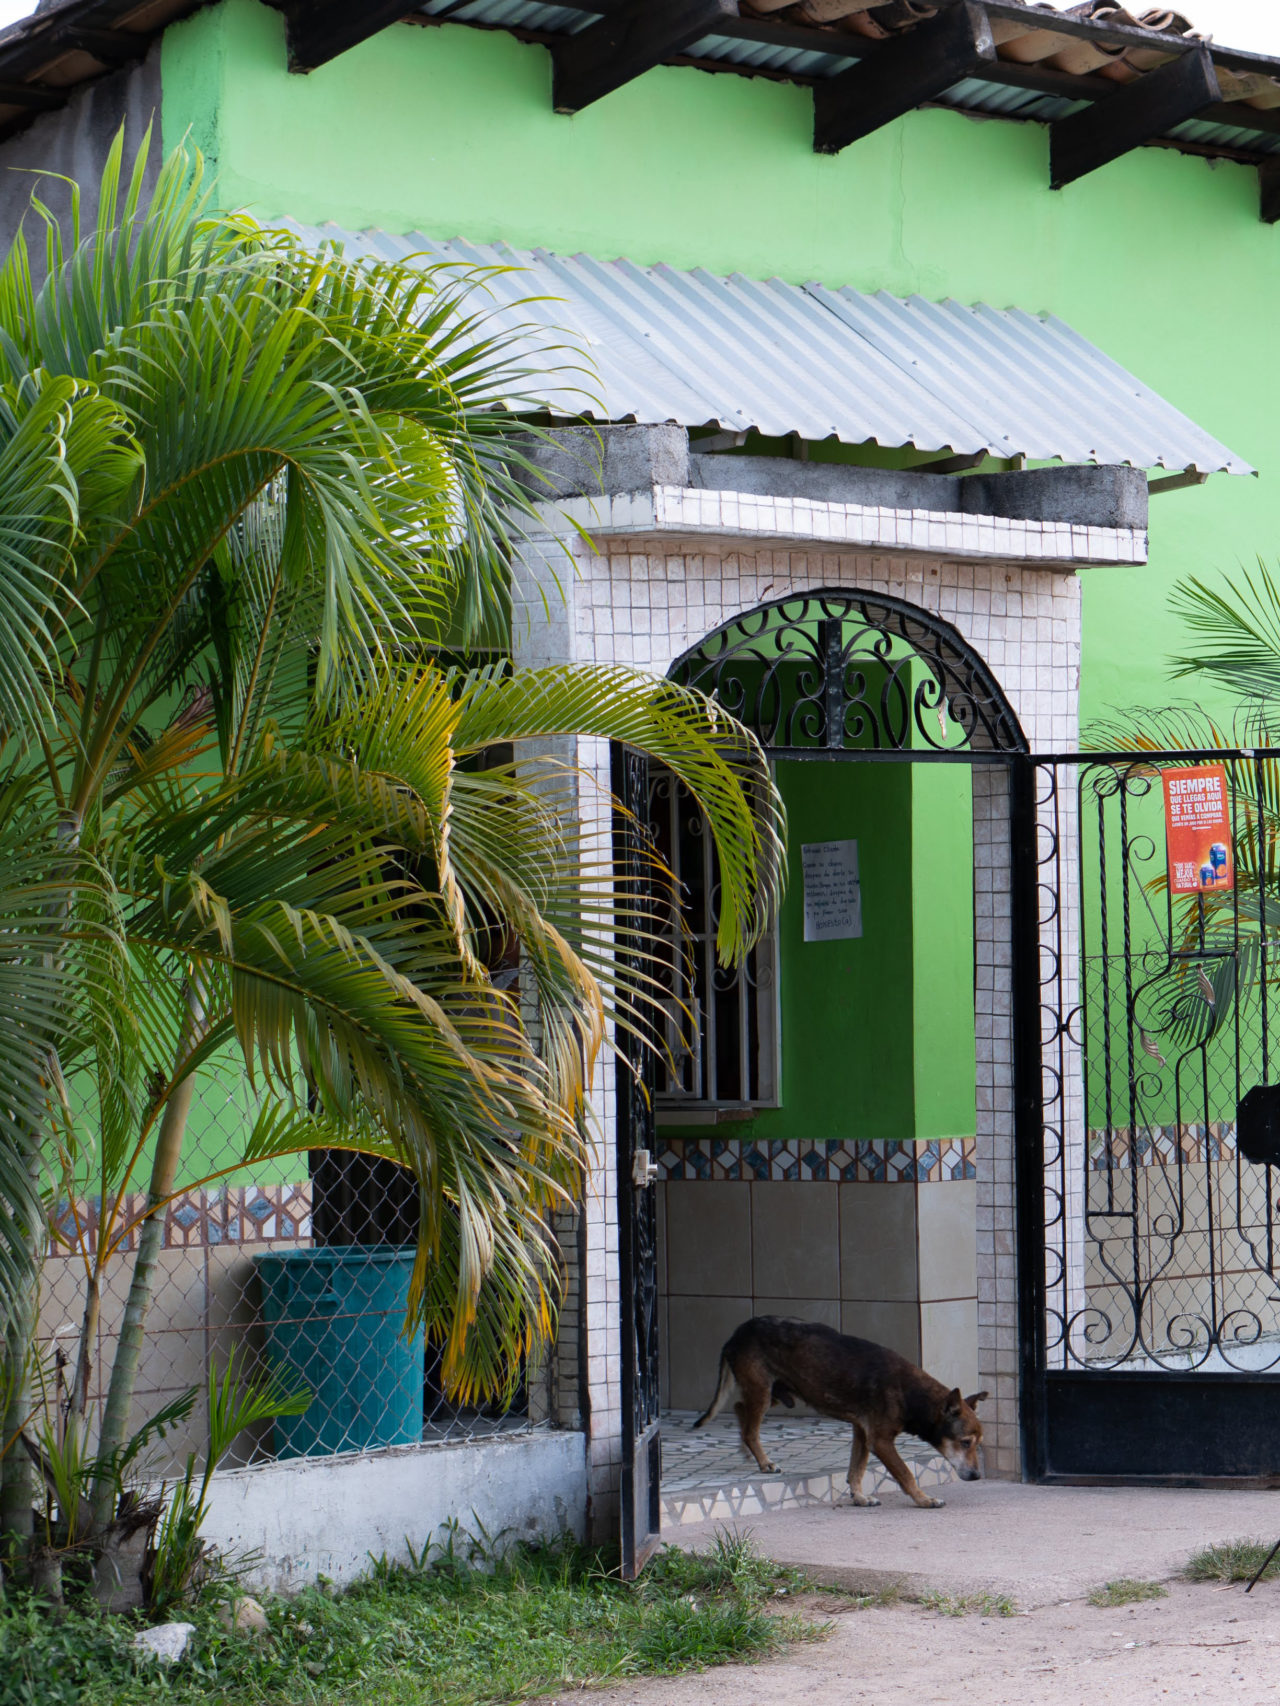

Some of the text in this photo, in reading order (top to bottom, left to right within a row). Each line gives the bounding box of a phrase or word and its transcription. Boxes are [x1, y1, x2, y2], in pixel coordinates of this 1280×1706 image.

[1169, 777, 1221, 794] SIEMPRE
[1170, 795, 1182, 804] QUE
[1183, 793, 1206, 803] LLEGAS
[1171, 801, 1223, 815] SE TE OLVIDA
